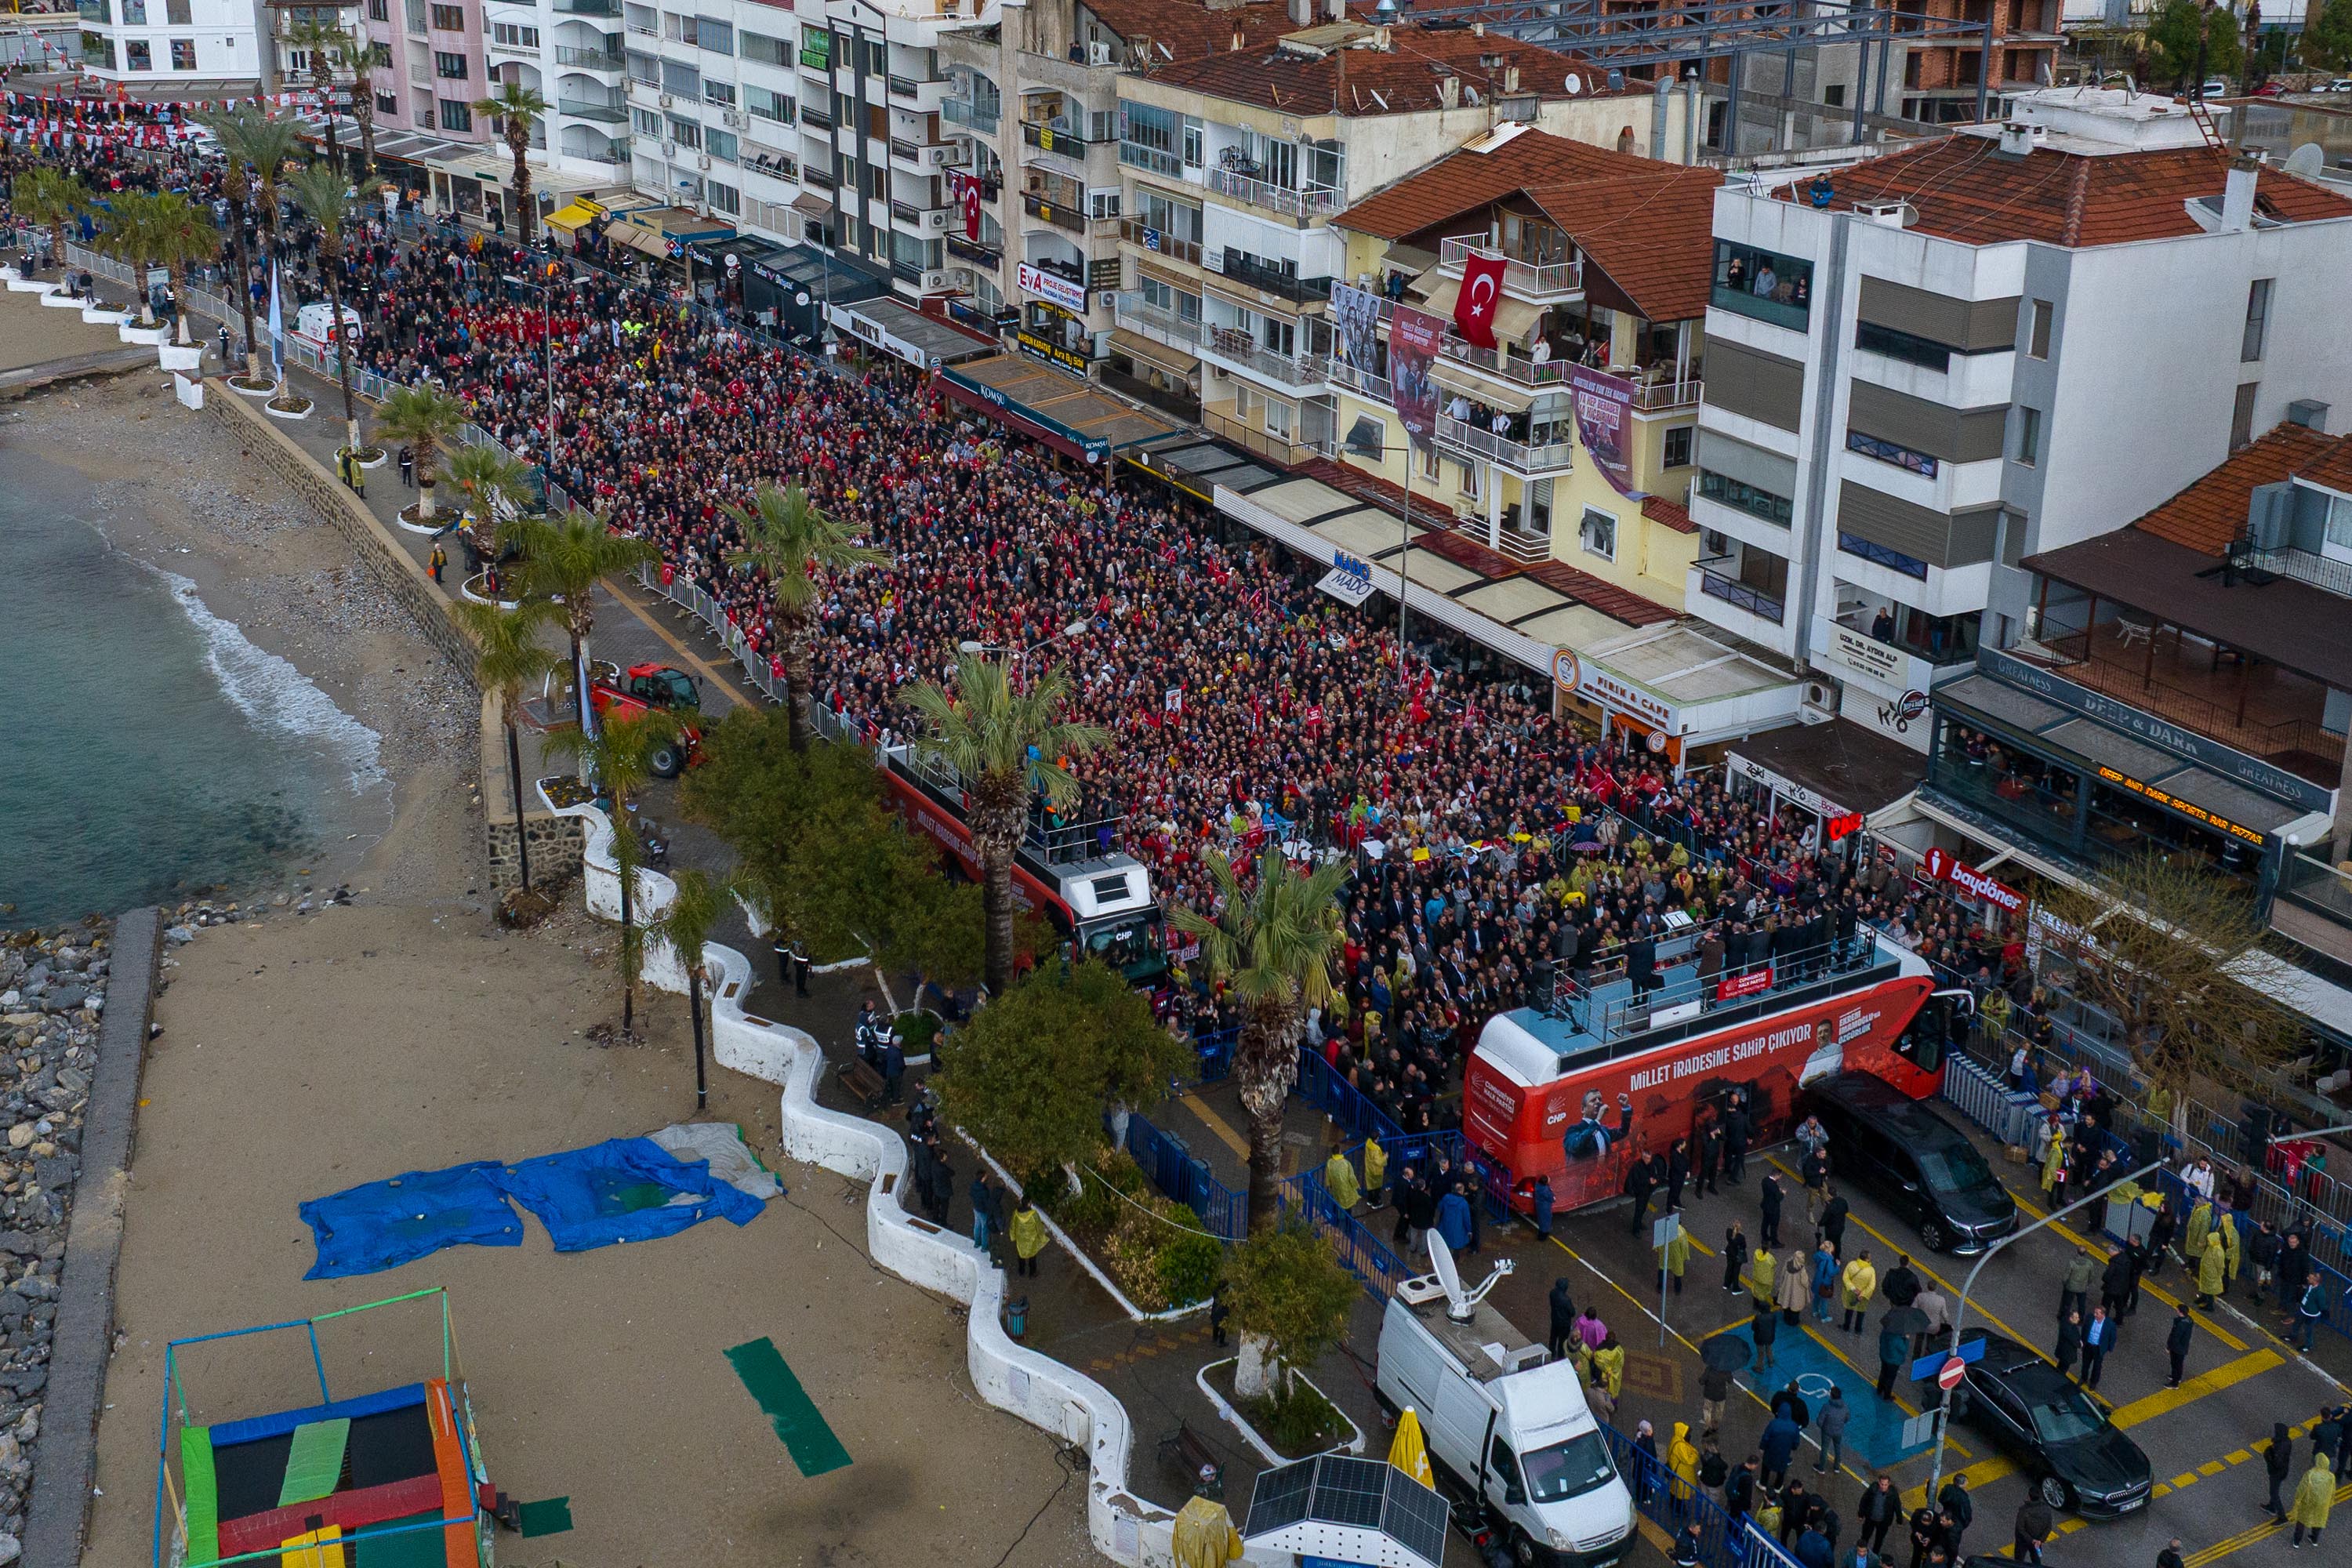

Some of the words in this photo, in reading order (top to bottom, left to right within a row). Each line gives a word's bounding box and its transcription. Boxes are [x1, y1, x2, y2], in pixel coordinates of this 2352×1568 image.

[1044, 278, 1058, 289] PROJE
[1054, 348, 1065, 360] Aura
[1065, 352, 1073, 365] By
[981, 384, 1004, 406] KOMŞU
[1587, 395, 1596, 408] HEP
[1406, 421, 1422, 434] CHP
[1334, 550, 1371, 581] MADO
[1331, 572, 1370, 595] MADO
[1840, 633, 1854, 645] UZM.
[1856, 640, 1865, 650] DR.
[1867, 645, 1885, 658] AYDIN
[1886, 653, 1898, 662] ALP
[1998, 658, 2052, 692] GREATNESS
[1598, 677, 1627, 697] FIRIN
[1630, 693, 1637, 702] &
[1641, 699, 1670, 719] CAFE
[2084, 693, 2129, 724] DEEP
[2132, 719, 2145, 731] &
[2149, 724, 2198, 755] DARK
[1746, 762, 1764, 779] Zeki
[2238, 759, 2302, 799] GREATNESS
[2099, 766, 2123, 782] DEEP
[2125, 778, 2143, 792] AND
[2145, 786, 2170, 804] DARK
[2171, 798, 2207, 820] SPORTS
[2209, 815, 2229, 829] BAR
[1951, 862, 2022, 909] baydöner
[1116, 931, 1133, 941] CHP
[1631, 1064, 1670, 1092] MİLLET
[1673, 1047, 1730, 1079] İRADESİNE
[1733, 1036, 1766, 1061] SAHİP
[1768, 1023, 1812, 1054] ÇIKIYOR
[1547, 1112, 1566, 1124] CHP
